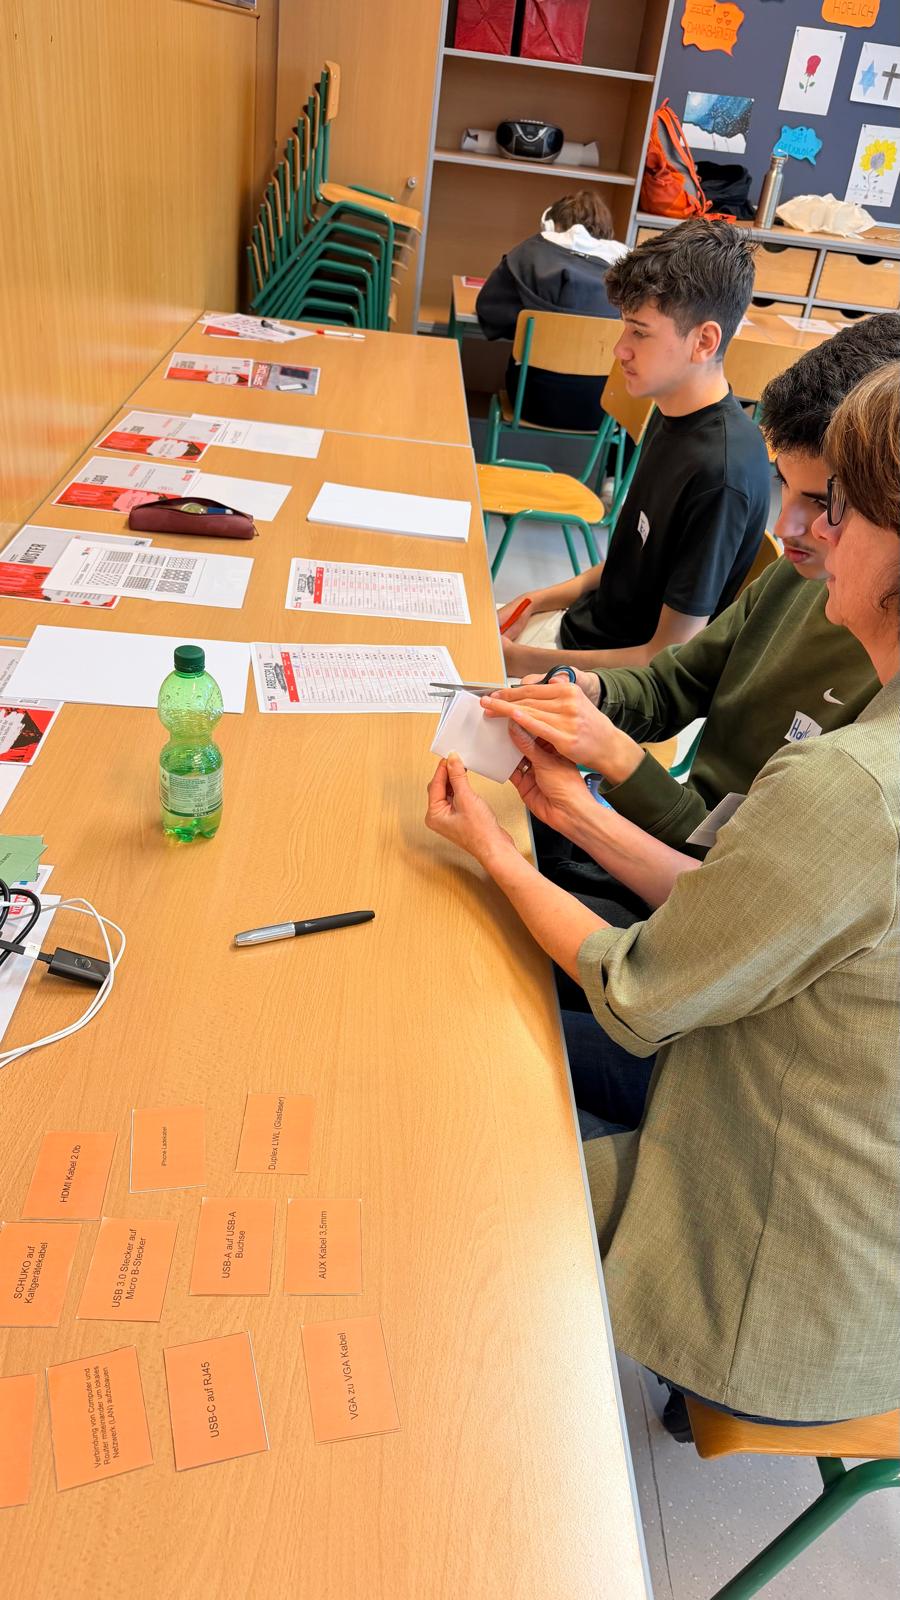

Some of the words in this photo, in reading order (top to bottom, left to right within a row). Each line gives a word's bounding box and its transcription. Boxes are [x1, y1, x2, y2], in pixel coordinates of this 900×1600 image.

[18, 543, 47, 563] MUSTER
[273, 1096, 285, 1130] (Glasfaser)
[272, 1131, 281, 1146] LWL
[71, 1145, 81, 1160] 2.0b
[268, 1147, 278, 1171] Duplex
[66, 1161, 77, 1181] Kabel
[60, 1182, 72, 1203] HDMI
[129, 1228, 137, 1241] auf
[227, 1211, 237, 1236] USB-A
[319, 1210, 328, 1236] 3,5mm
[226, 1238, 234, 1250] auf
[235, 1230, 246, 1259] Buchse
[319, 1238, 328, 1260] Kabel
[120, 1243, 134, 1273] Stecker
[131, 1238, 147, 1275] B-Stecker
[222, 1251, 232, 1279] USB-A
[14, 1260, 31, 1300] SCHUKO
[27, 1246, 36, 1259] auf
[24, 1242, 48, 1304] Kaltgerätekabel
[117, 1274, 126, 1287] 3.0
[319, 1261, 327, 1280] AUX
[112, 1289, 123, 1308] USB
[125, 1277, 138, 1300] Micro
[337, 1332, 349, 1359] Kabel
[93, 1365, 101, 1388] lokales
[200, 1361, 212, 1386] RJ45
[342, 1360, 353, 1382] VGA
[97, 1389, 103, 1400] um
[103, 1366, 113, 1403] aufzubauen
[204, 1387, 215, 1402] auf
[348, 1383, 355, 1395] zu
[87, 1382, 96, 1414] Computer
[348, 1397, 359, 1420] VGA
[98, 1402, 108, 1438] miteinander
[107, 1404, 116, 1425] (LAN)
[207, 1404, 220, 1438] USB-C
[92, 1427, 102, 1468] Verbindung
[111, 1427, 120, 1459] Netzwerk
